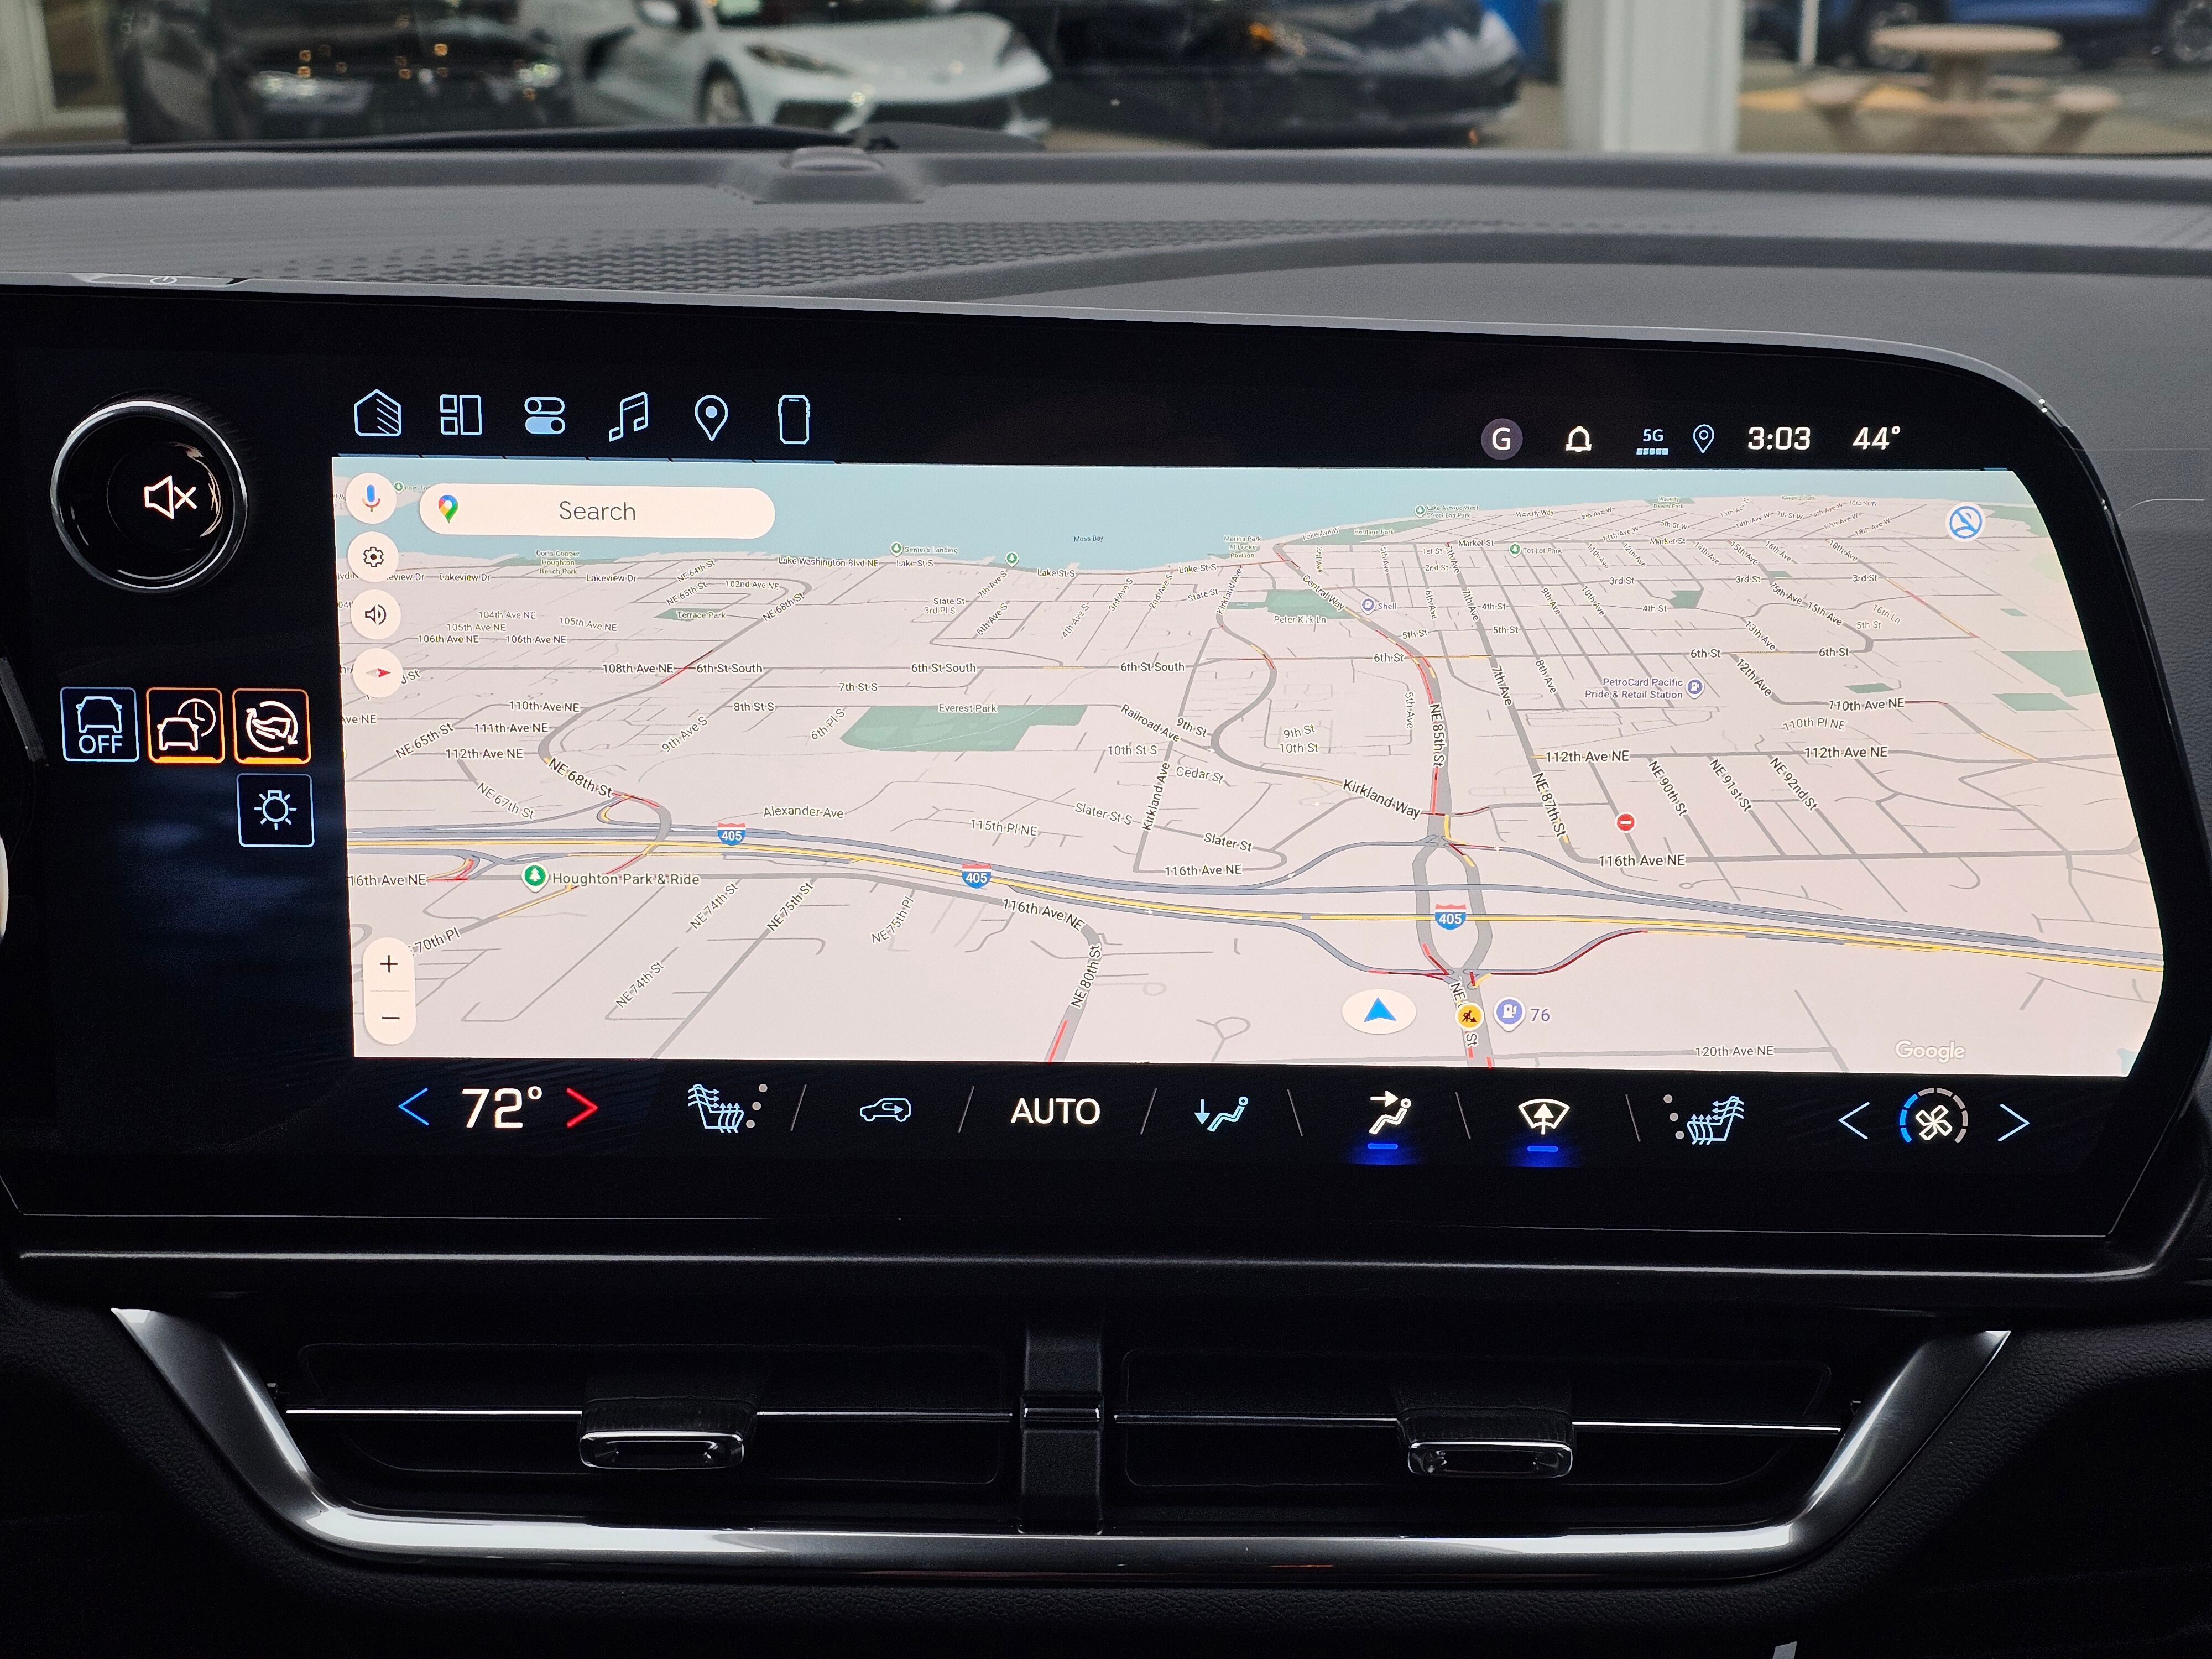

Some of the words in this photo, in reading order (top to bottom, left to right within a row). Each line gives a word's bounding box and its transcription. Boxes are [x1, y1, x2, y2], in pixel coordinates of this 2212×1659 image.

[1491, 427, 1511, 451] G
[1642, 428, 1664, 442] 5G
[1747, 426, 1811, 451] 3:03
[559, 501, 636, 520] Search
[541, 559, 575, 567] Houghton
[439, 572, 479, 581] Lakeview
[481, 573, 491, 581] Dr
[586, 573, 625, 582] Lakeview
[1303, 576, 1328, 598] Central
[1329, 596, 1345, 611] Way
[447, 623, 472, 631] 105th
[493, 623, 506, 632] NE
[560, 617, 585, 627] 105th
[586, 620, 603, 630] Ave
[605, 623, 618, 632] NE
[1856, 621, 1870, 629] 5th
[418, 635, 444, 643] 106th
[505, 635, 531, 643] 106th
[1402, 630, 1416, 639] 5th
[1691, 649, 1707, 658] 6th
[1710, 649, 1721, 658] St
[1819, 648, 1835, 656] 6th
[1838, 648, 1849, 656] St
[1374, 653, 1390, 662] 6th
[1393, 653, 1404, 661] St
[603, 664, 633, 673] 108th
[635, 665, 656, 673] Ave
[659, 665, 674, 673] NE
[697, 664, 714, 673] 6th
[717, 665, 728, 673] St
[731, 664, 763, 673] South
[911, 664, 928, 672] 6th
[931, 664, 942, 672] St
[945, 663, 976, 672] South
[1120, 662, 1137, 672] 6th
[1140, 663, 1151, 672] St
[1154, 662, 1185, 671] South
[1603, 677, 1649, 686] PetroCard
[1652, 677, 1683, 686] Pacific
[838, 683, 854, 691] 7th
[1585, 690, 1609, 698] Pride
[1611, 690, 1619, 698] &
[1621, 690, 1647, 698] Retail
[1650, 690, 1683, 698] Station
[509, 702, 539, 711] 110th
[541, 702, 561, 711] Ave
[565, 703, 580, 711] NE
[733, 703, 750, 711] 8th
[753, 703, 764, 711] St
[975, 704, 997, 712] Park
[1829, 700, 1861, 711] 110th
[1865, 700, 1885, 710] Ave
[1887, 697, 1905, 708] NE
[474, 723, 505, 732] 111th
[508, 724, 529, 732] Ave
[533, 724, 549, 732] NE
[1121, 704, 1161, 732] Railroad
[1161, 729, 1180, 742] Ave
[1783, 718, 1814, 731] 110th
[1817, 719, 1829, 728] Pl
[1830, 719, 1847, 731] NE
[1284, 728, 1300, 738] 9th
[1303, 726, 1314, 734] St
[78, 735, 123, 754] OFF
[1279, 744, 1303, 753] 10th
[1307, 744, 1319, 753] St
[445, 749, 478, 758] 112th
[482, 750, 504, 758] Ave
[507, 750, 524, 758] NE
[1108, 746, 1132, 754] 10th
[1135, 746, 1147, 754] St
[1150, 746, 1157, 754] S
[1804, 746, 1839, 758] 112th
[1843, 747, 1866, 757] Ave
[1870, 747, 1888, 757] NE
[1546, 751, 1580, 762] 112th
[1584, 752, 1608, 761] Ave
[1611, 751, 1629, 761] NE
[1177, 768, 1210, 779] Cedar
[1213, 773, 1224, 784] St
[1343, 779, 1394, 807] Kirkland
[1396, 801, 1421, 820] Way
[763, 808, 820, 818] Alexander
[823, 809, 844, 818] Ave
[971, 821, 1003, 832] 115th
[1006, 824, 1018, 834] Pl
[1021, 826, 1038, 836] NE
[721, 831, 743, 841] 405
[1204, 833, 1238, 848] Slater
[1240, 841, 1253, 851] St
[1599, 855, 1635, 866] 116th
[1639, 855, 1662, 865] Ave
[1667, 855, 1684, 865] NE
[1164, 865, 1197, 876] 116th
[1201, 865, 1222, 875] Ave
[1225, 865, 1242, 874] NE
[553, 874, 618, 886] Houghton
[623, 874, 654, 884] Park
[657, 875, 666, 884] &
[671, 874, 700, 885] Ride
[965, 873, 988, 883] 405
[1003, 899, 1038, 914] 116th
[1042, 906, 1064, 920] Ave
[1067, 914, 1084, 931] NE
[1438, 913, 1462, 924] 405
[1071, 989, 1086, 1008] NE
[1081, 962, 1099, 988] 80th
[1090, 945, 1100, 959] St
[1530, 1008, 1550, 1021] 76
[1694, 1045, 1728, 1056] 120th
[1731, 1046, 1754, 1056] Ave
[1757, 1045, 1774, 1055] NE
[1895, 1041, 1966, 1063] Google
[1010, 1098, 1100, 1125] AUTO
